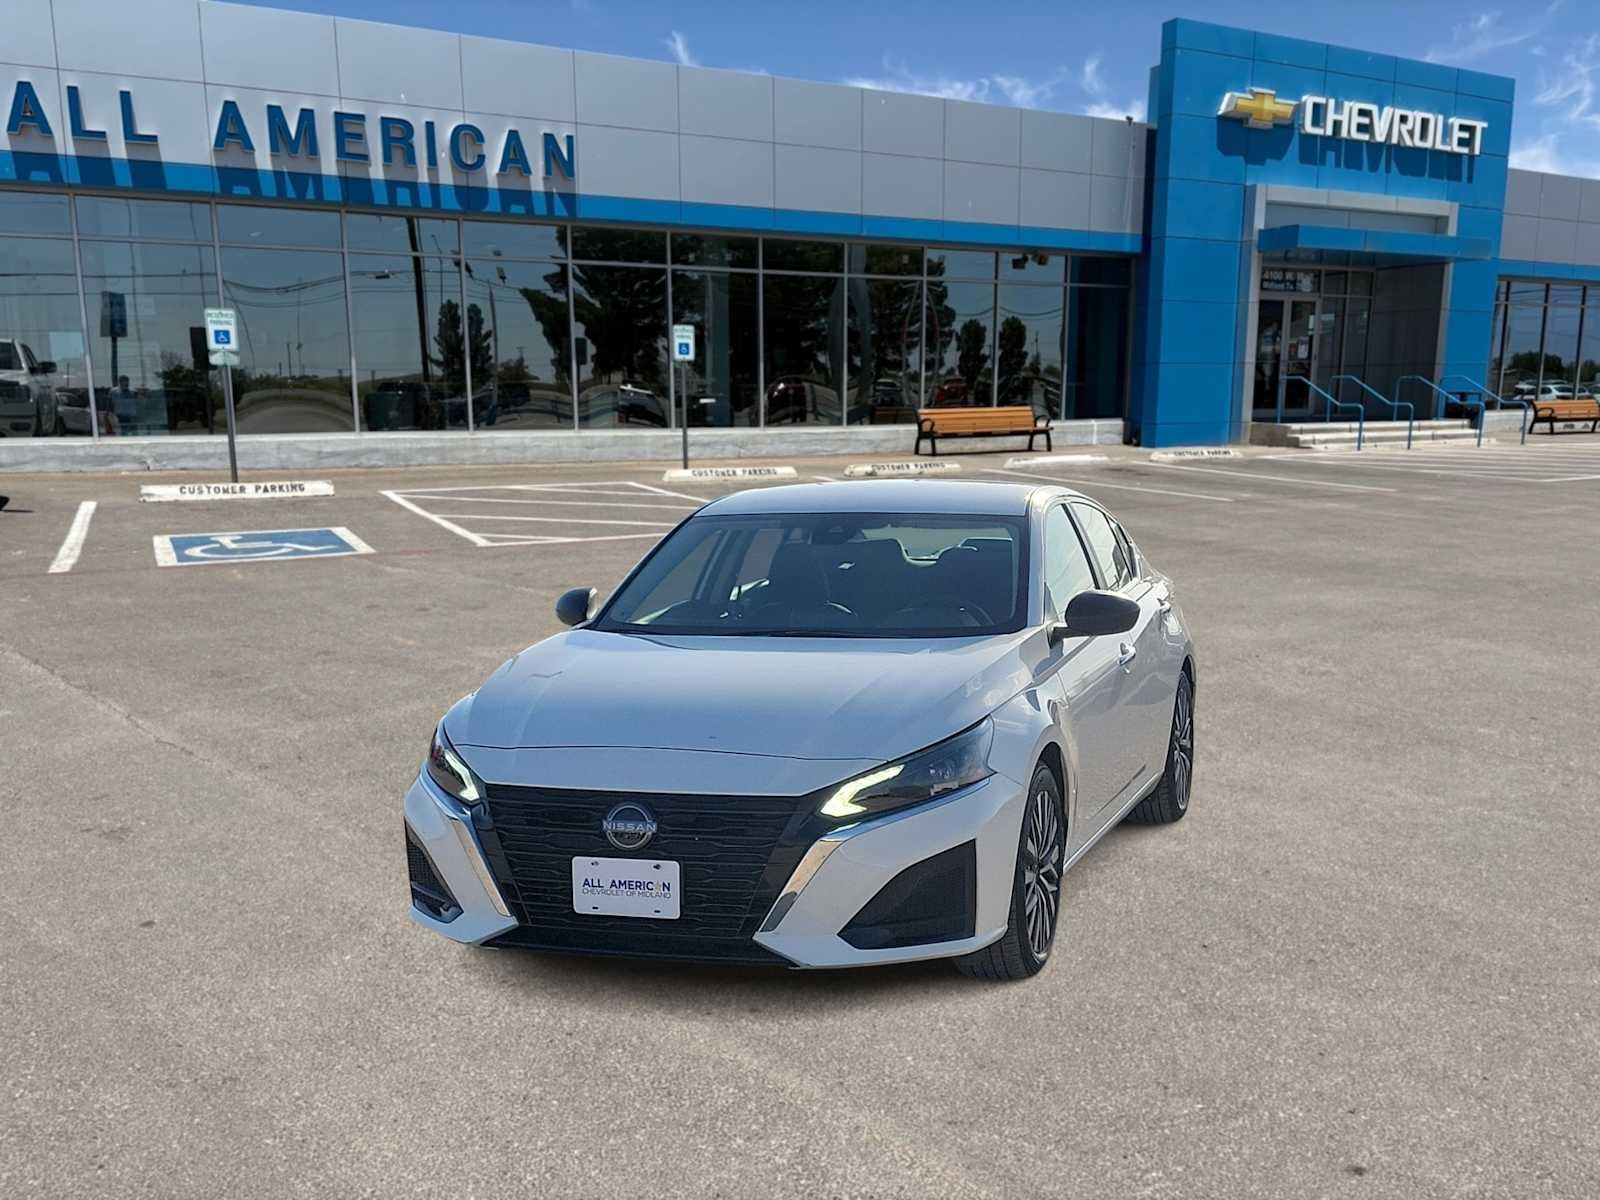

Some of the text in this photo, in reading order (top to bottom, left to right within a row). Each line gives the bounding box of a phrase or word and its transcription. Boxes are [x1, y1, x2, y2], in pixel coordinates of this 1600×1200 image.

[7, 80, 577, 180] ALL AMERICAN
[1302, 94, 1488, 156] CHEVROLET
[692, 468, 777, 477] CUSTOMER PARKING
[871, 463, 910, 471] CUSTOMER
[179, 483, 306, 495] CUSTOMER PARKING
[602, 820, 657, 833] NISSAN
[582, 878, 604, 888] ALL
[582, 888, 624, 897] CHEVROLET
[637, 890, 672, 899] MIDLAND
